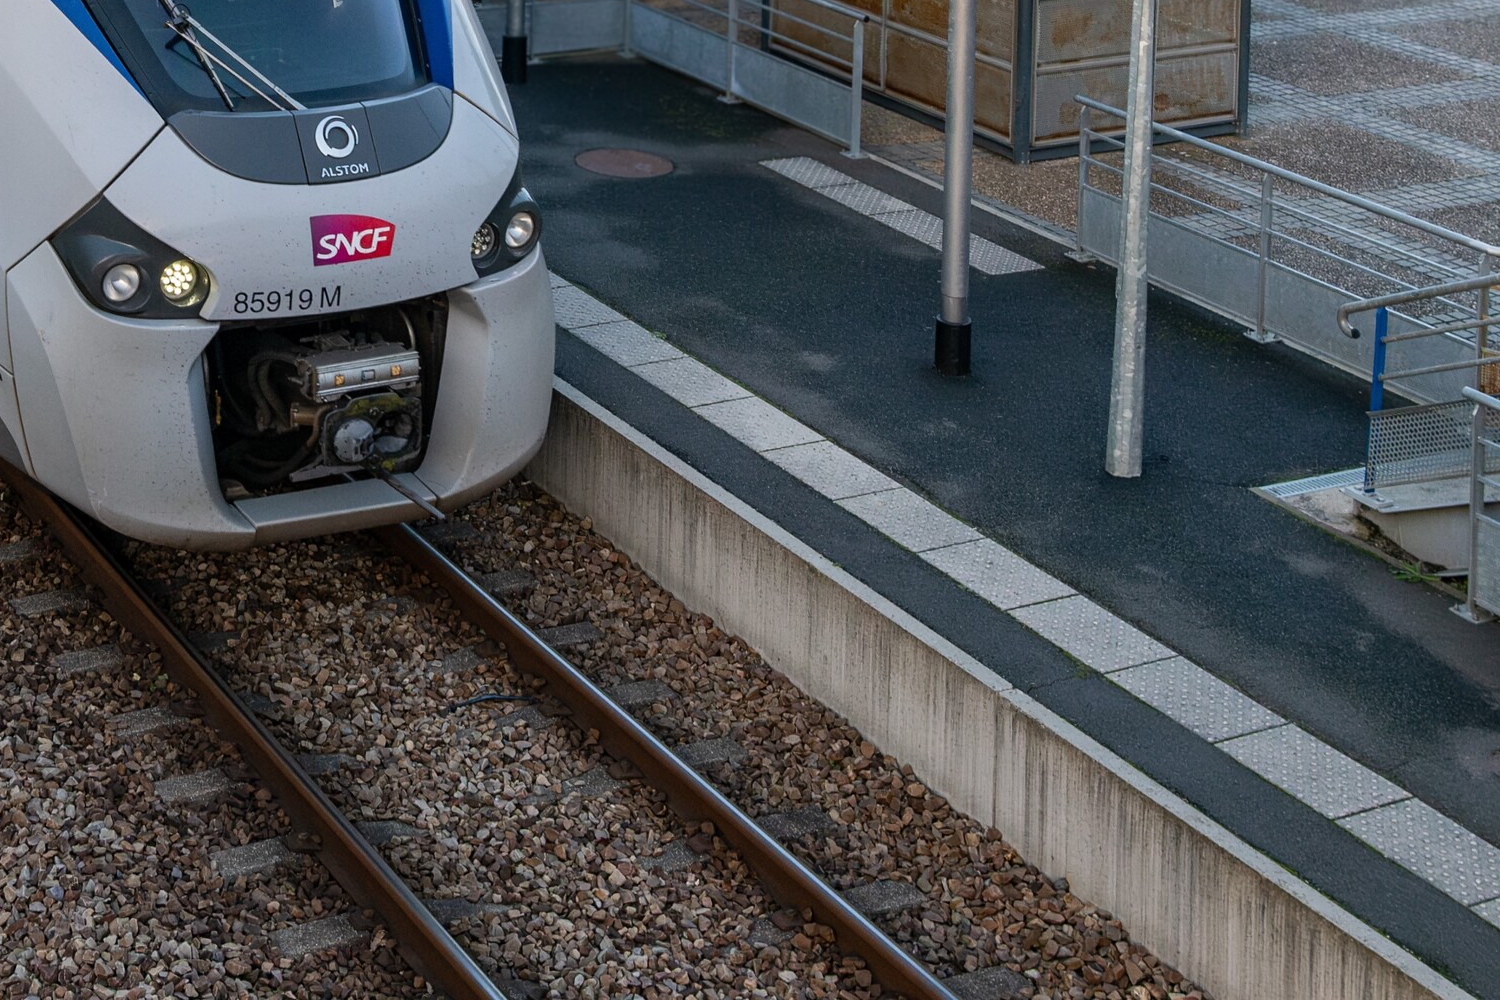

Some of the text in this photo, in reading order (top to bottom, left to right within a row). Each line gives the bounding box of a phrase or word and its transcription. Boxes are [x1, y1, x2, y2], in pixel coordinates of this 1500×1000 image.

[321, 162, 370, 178] ALSTOM
[316, 226, 391, 260] SNCF
[233, 285, 342, 314] 85919 M
